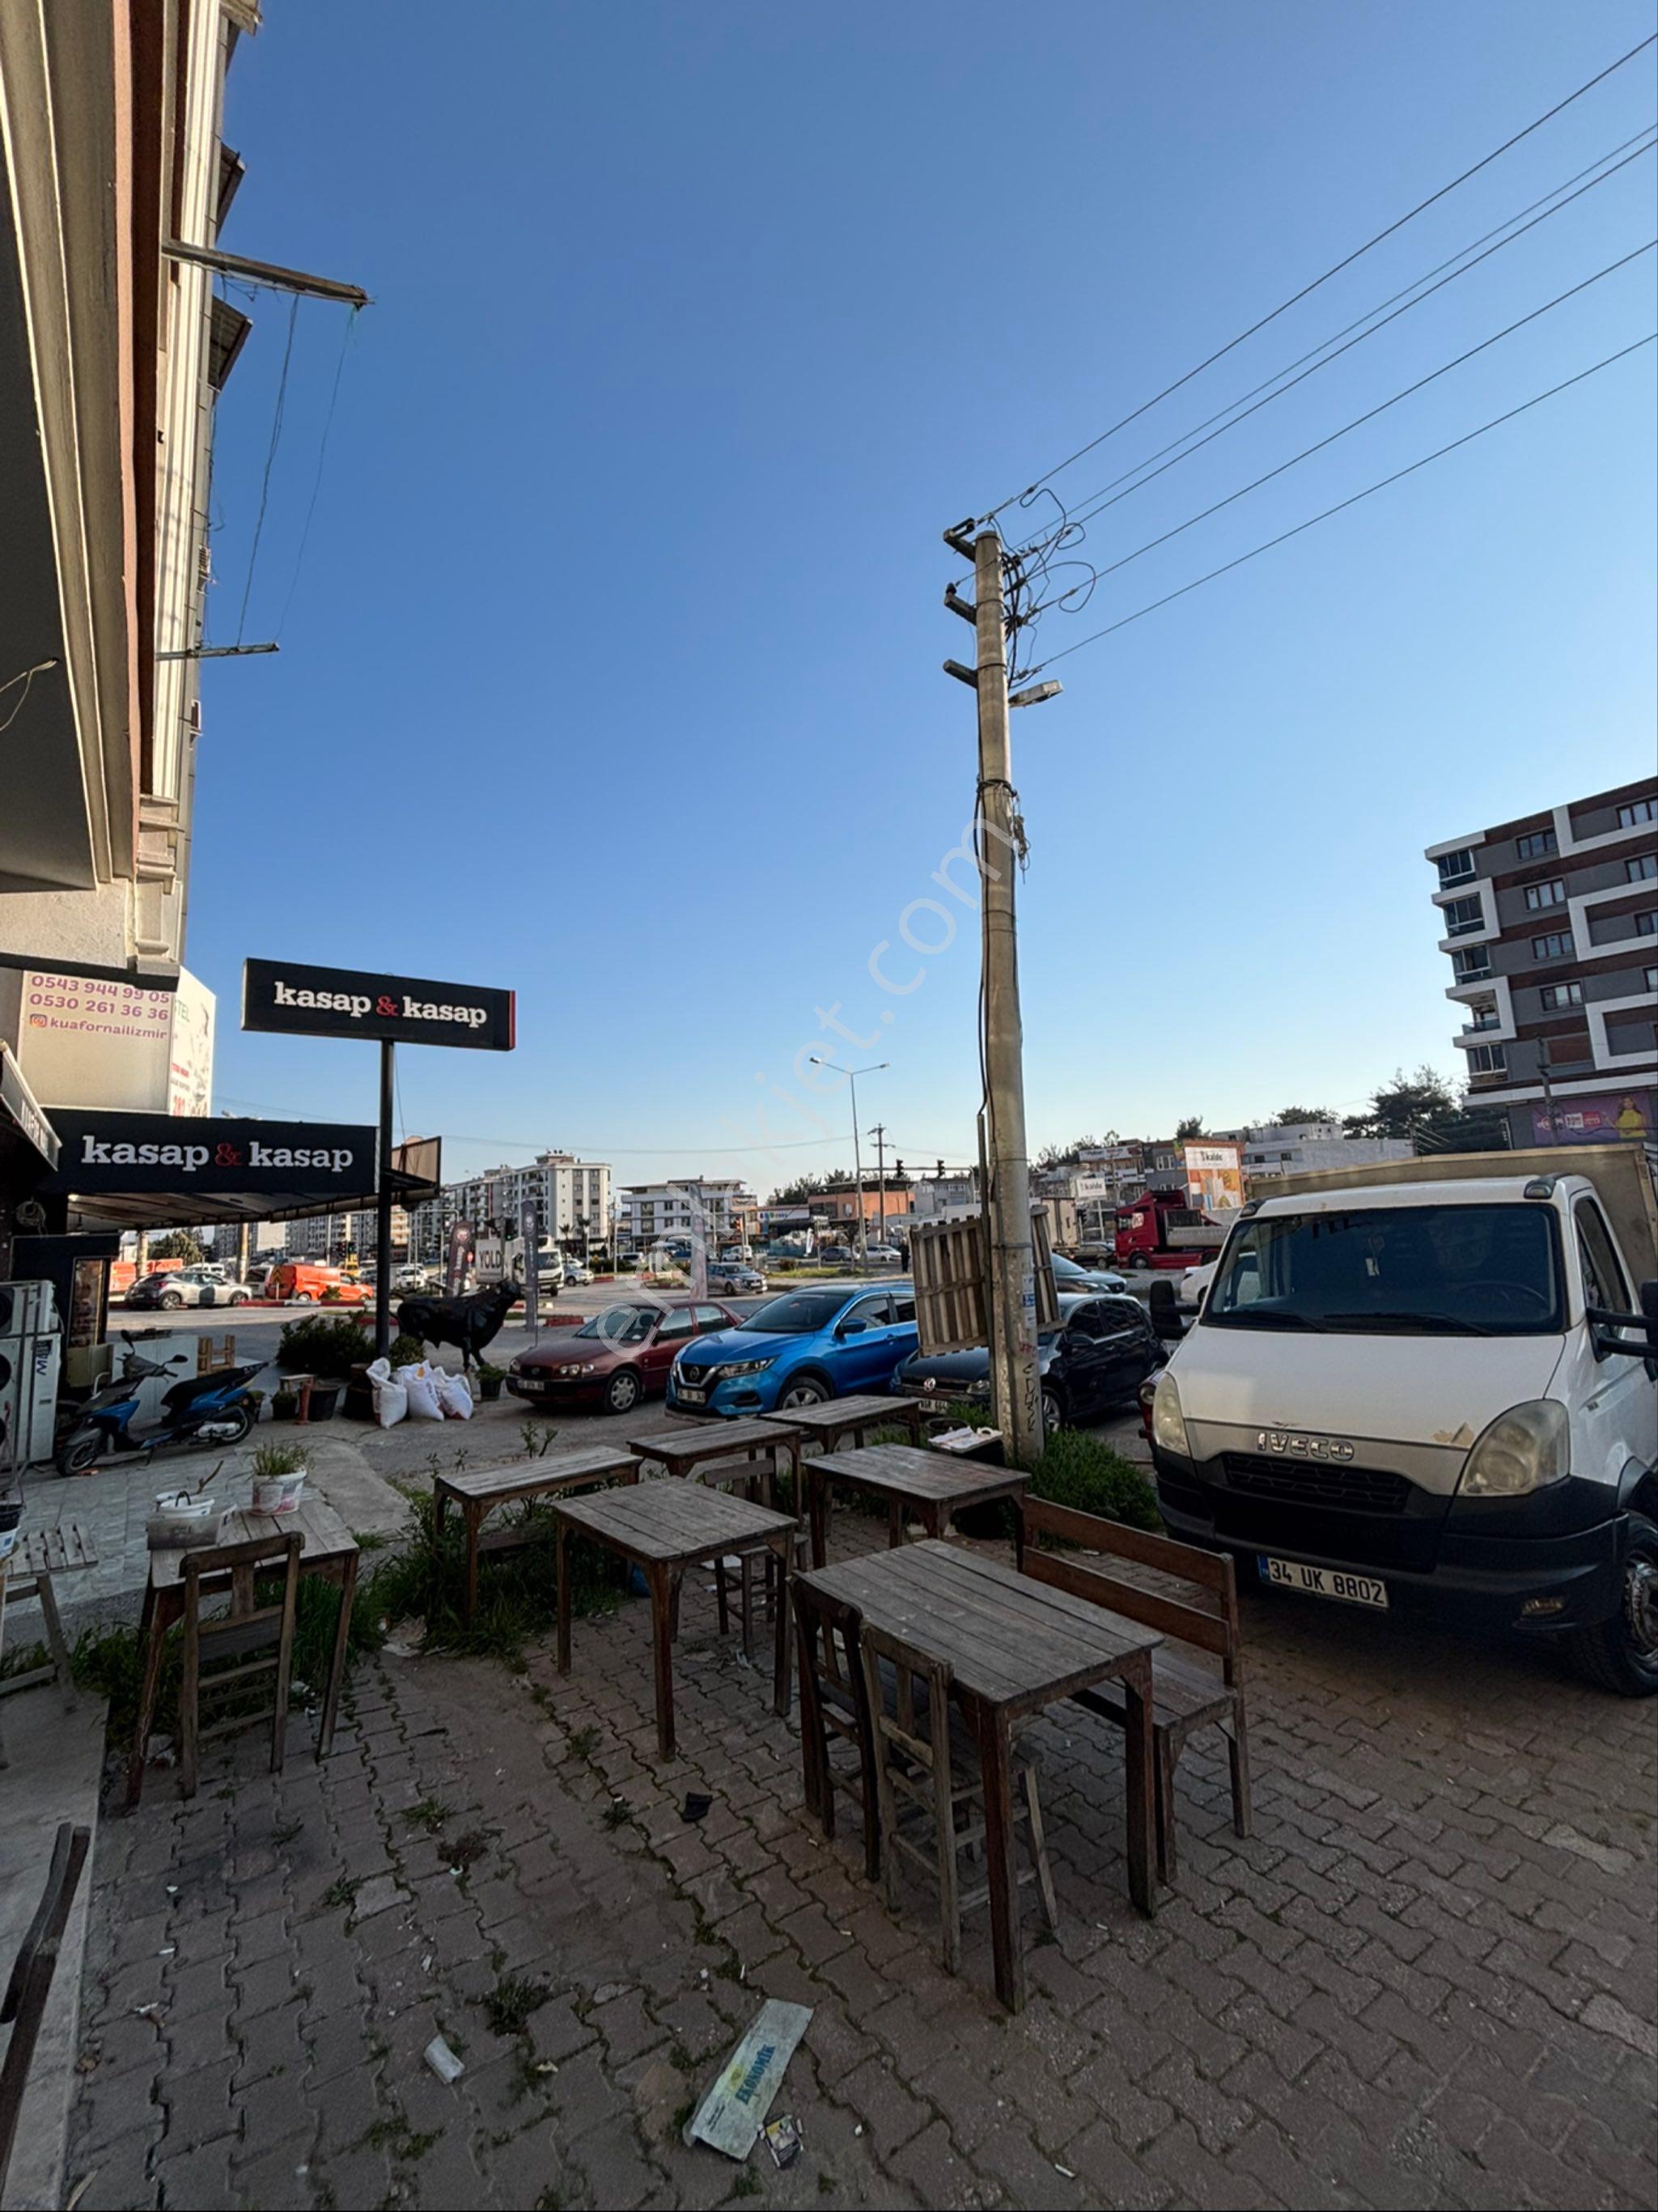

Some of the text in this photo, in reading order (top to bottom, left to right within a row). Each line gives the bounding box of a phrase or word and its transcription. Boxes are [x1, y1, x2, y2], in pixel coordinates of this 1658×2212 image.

[31, 975, 170, 1004] 0543 944 99 05
[29, 993, 169, 1021] 0530 261 36 36
[274, 981, 487, 1029] kasap & kasap
[50, 1017, 167, 1039] kuafornailizmir
[81, 1136, 354, 1172] kasap & kasap
[1257, 1432, 1355, 1462] IVECO
[1270, 1560, 1384, 1604] 34 UK 8802
